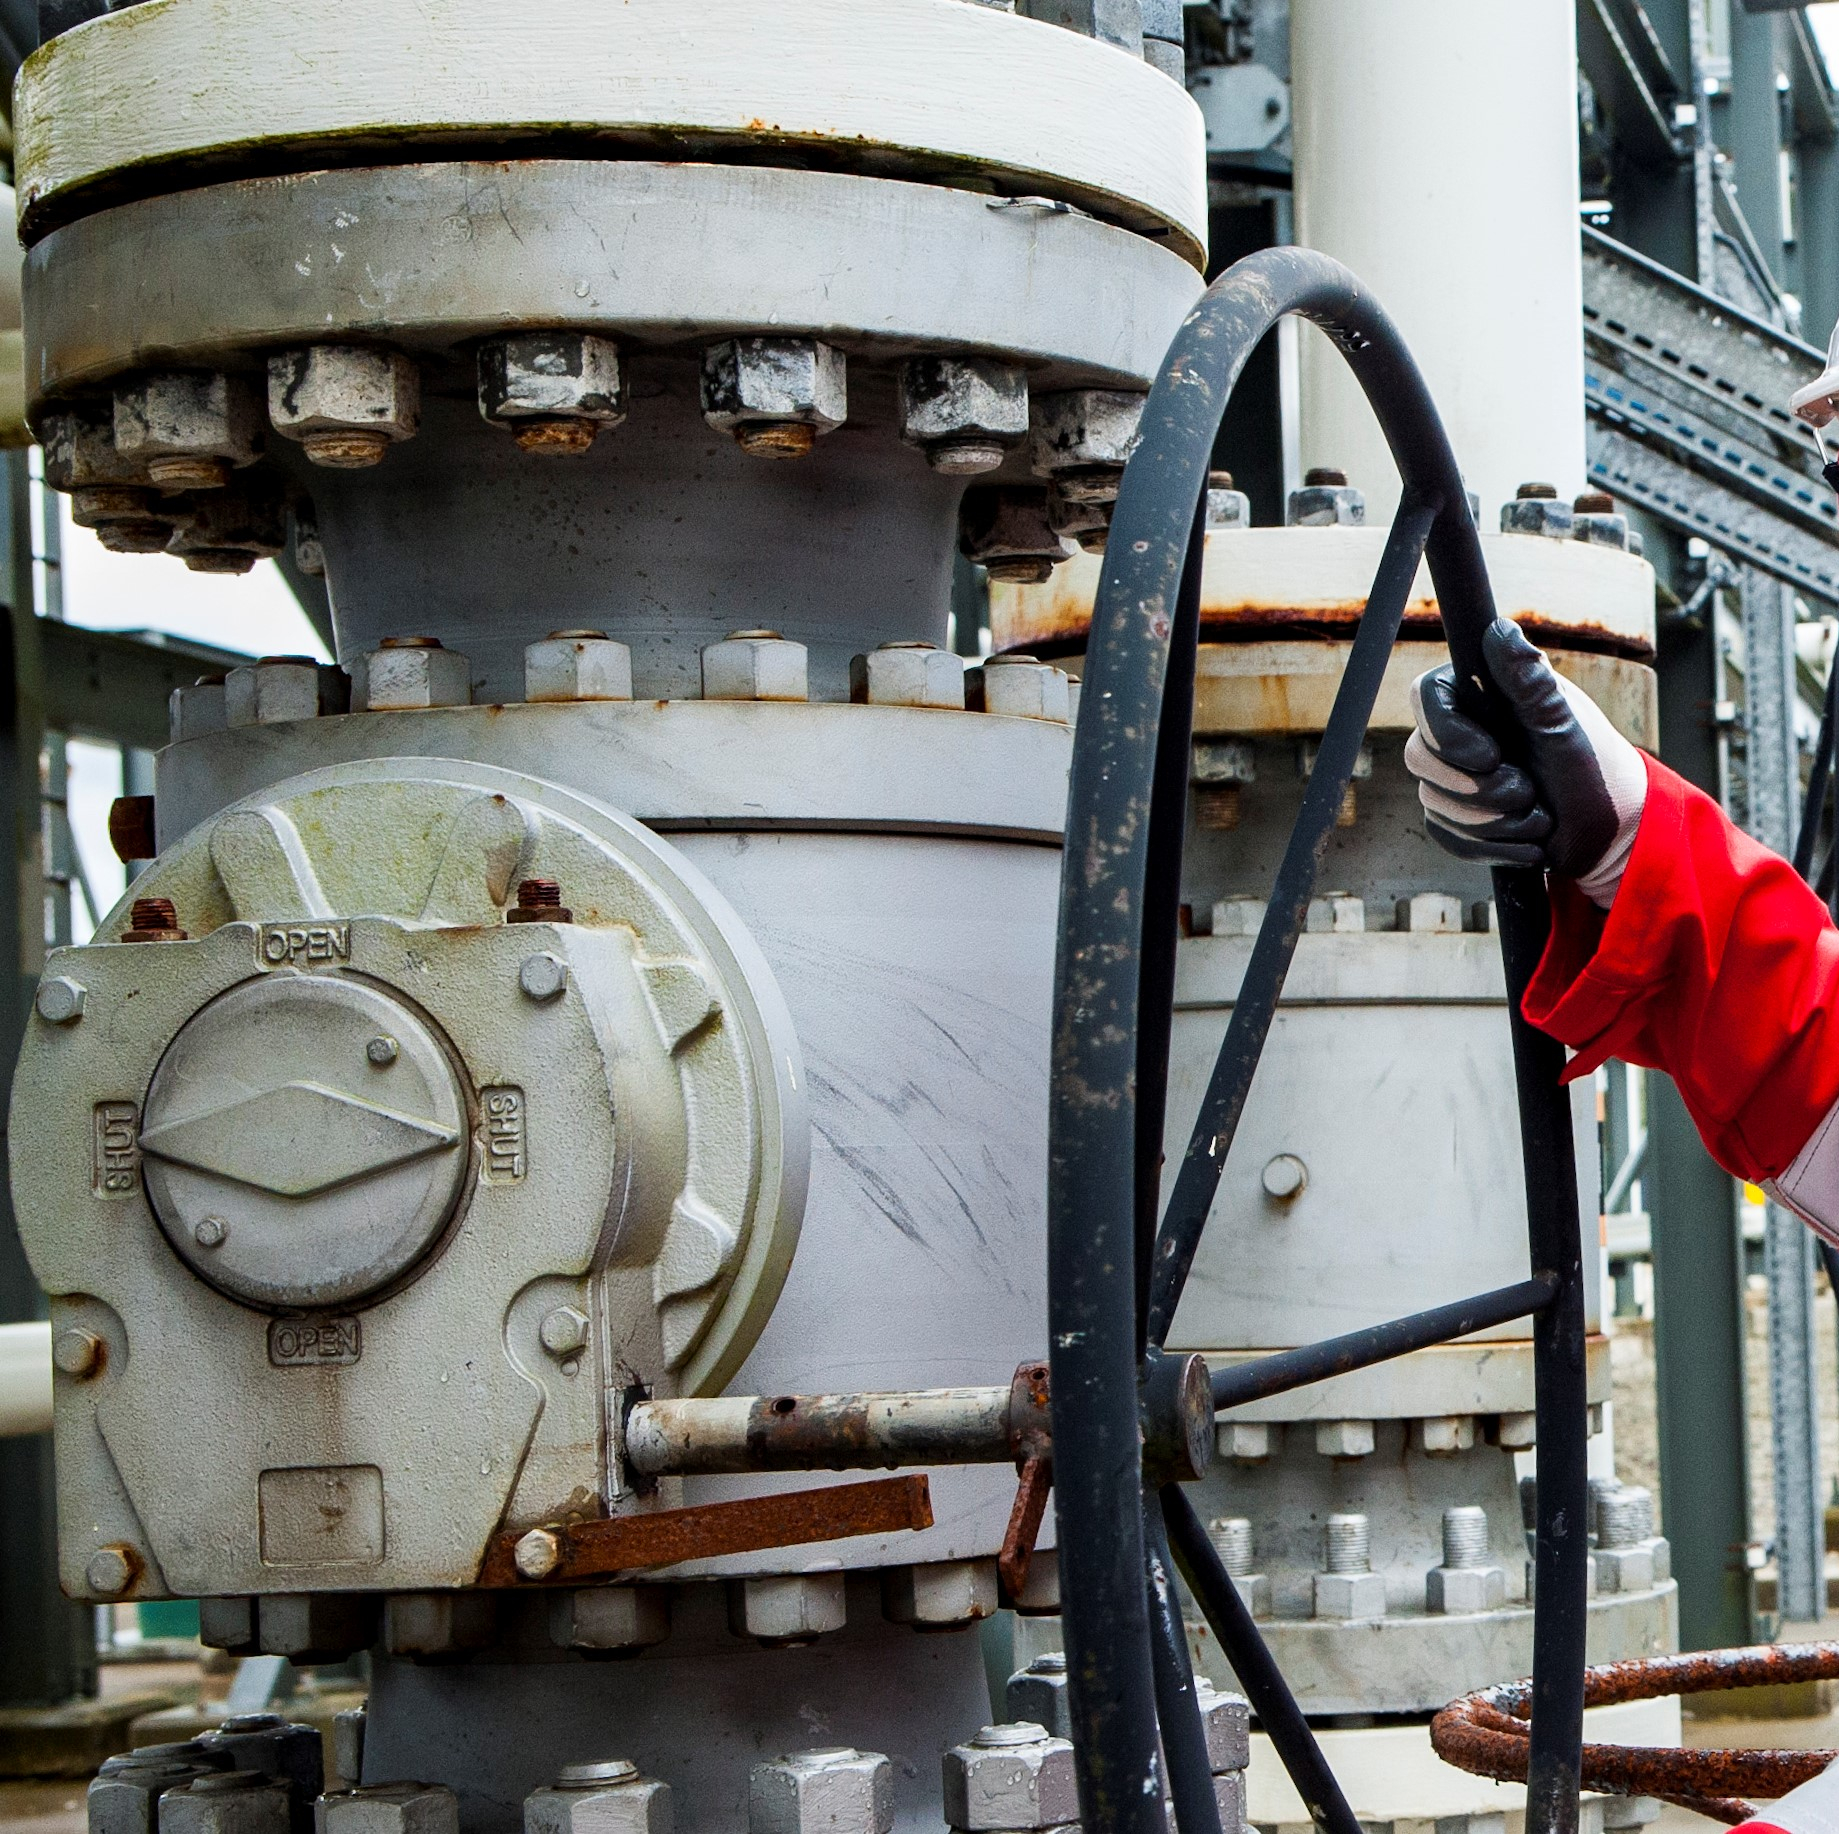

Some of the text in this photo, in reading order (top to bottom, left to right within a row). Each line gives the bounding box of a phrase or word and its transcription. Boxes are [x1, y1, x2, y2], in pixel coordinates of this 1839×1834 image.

[266, 927, 348, 961] OPEN
[104, 1109, 134, 1190] SHUT
[489, 1094, 520, 1178] SHUT
[276, 1325, 358, 1358] OPEN
